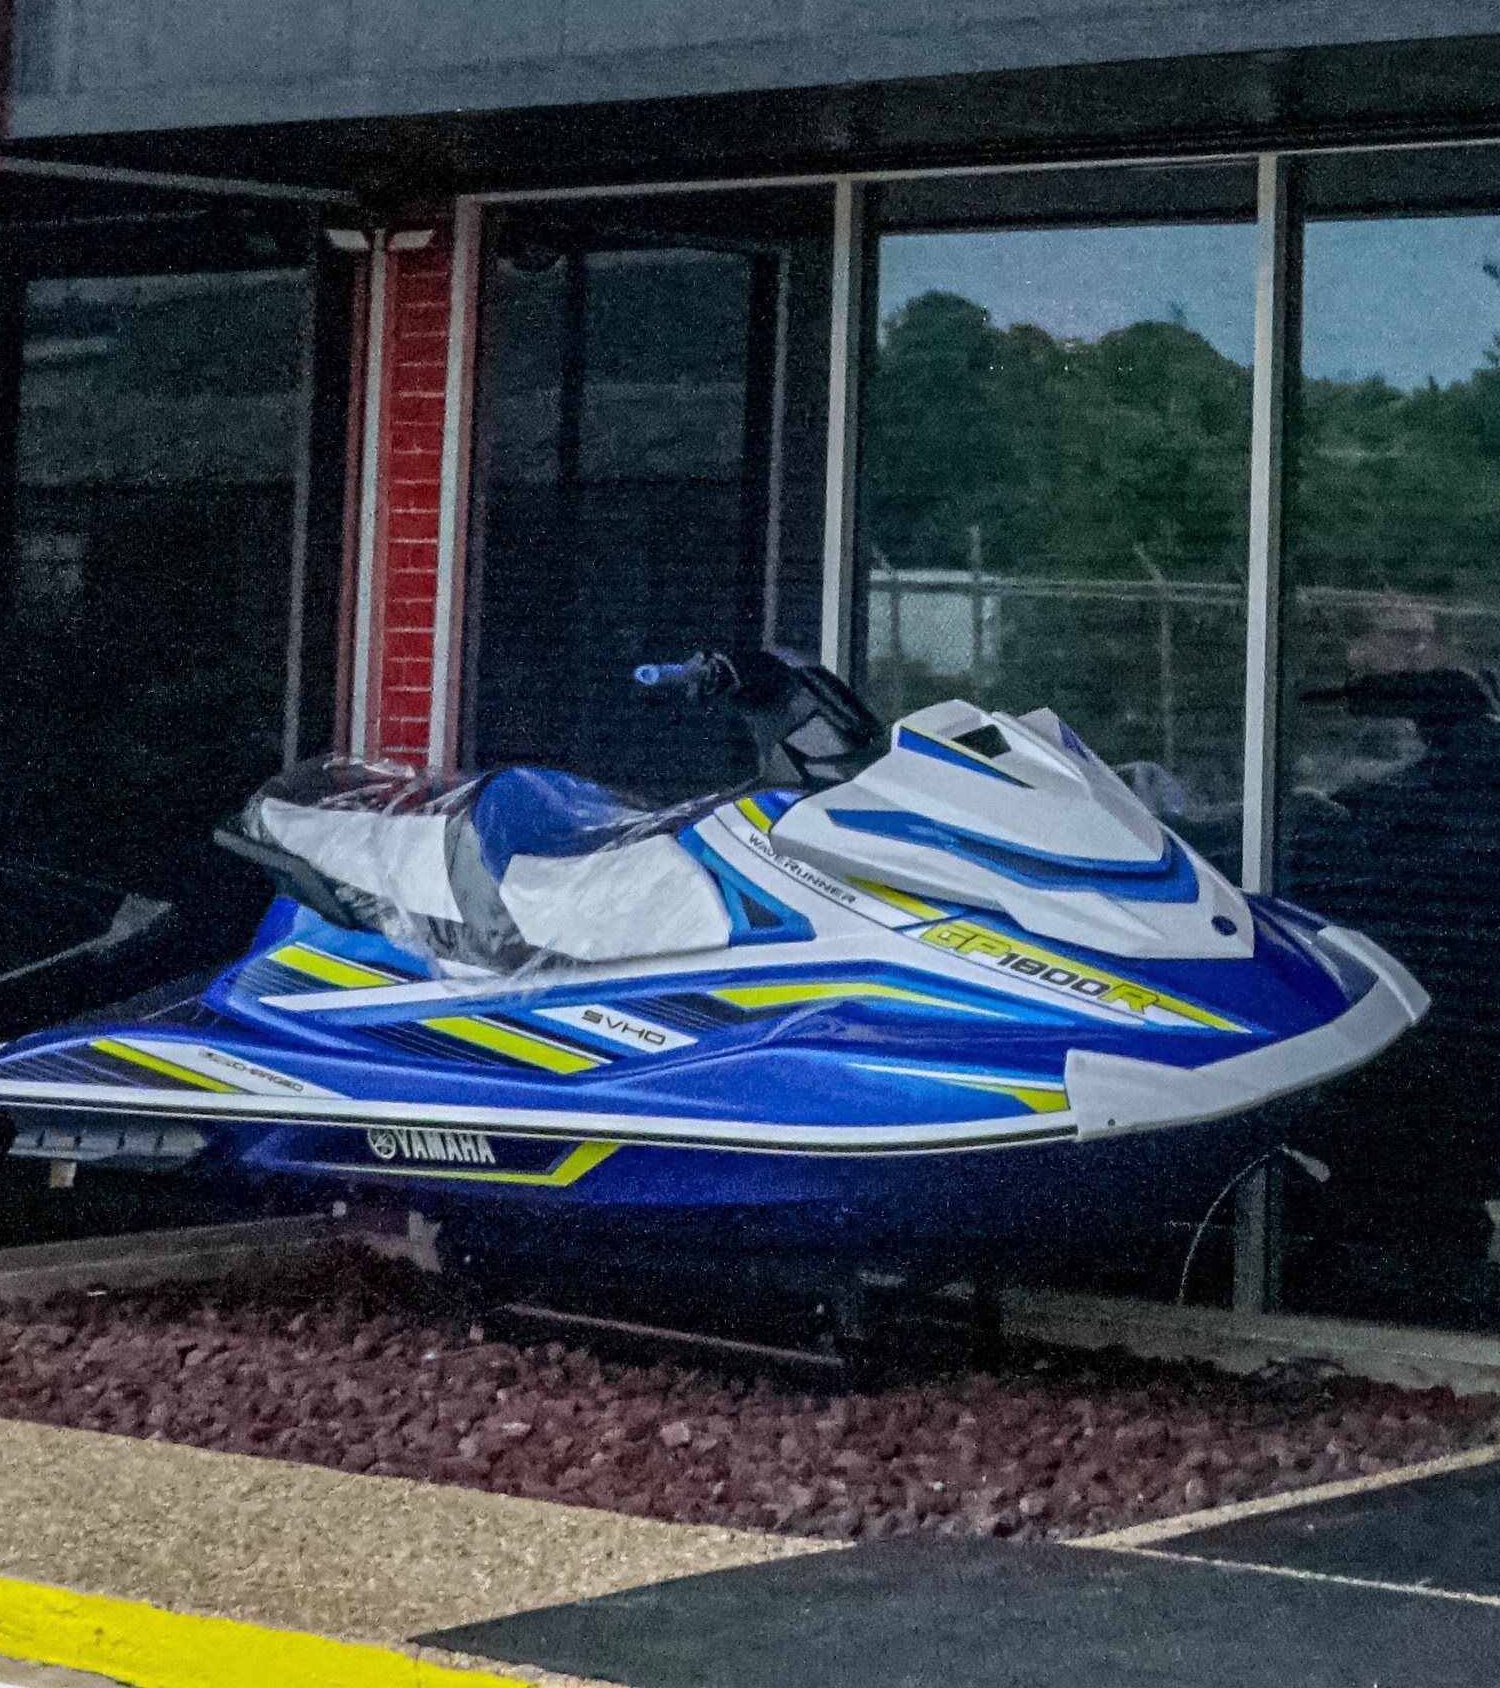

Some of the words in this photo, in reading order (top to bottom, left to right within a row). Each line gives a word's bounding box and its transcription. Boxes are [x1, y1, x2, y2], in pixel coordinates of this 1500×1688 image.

[920, 920, 1160, 1015] GP1800R
[580, 1008, 667, 1047] SVHO
[396, 1127, 497, 1164] YAMAHA
